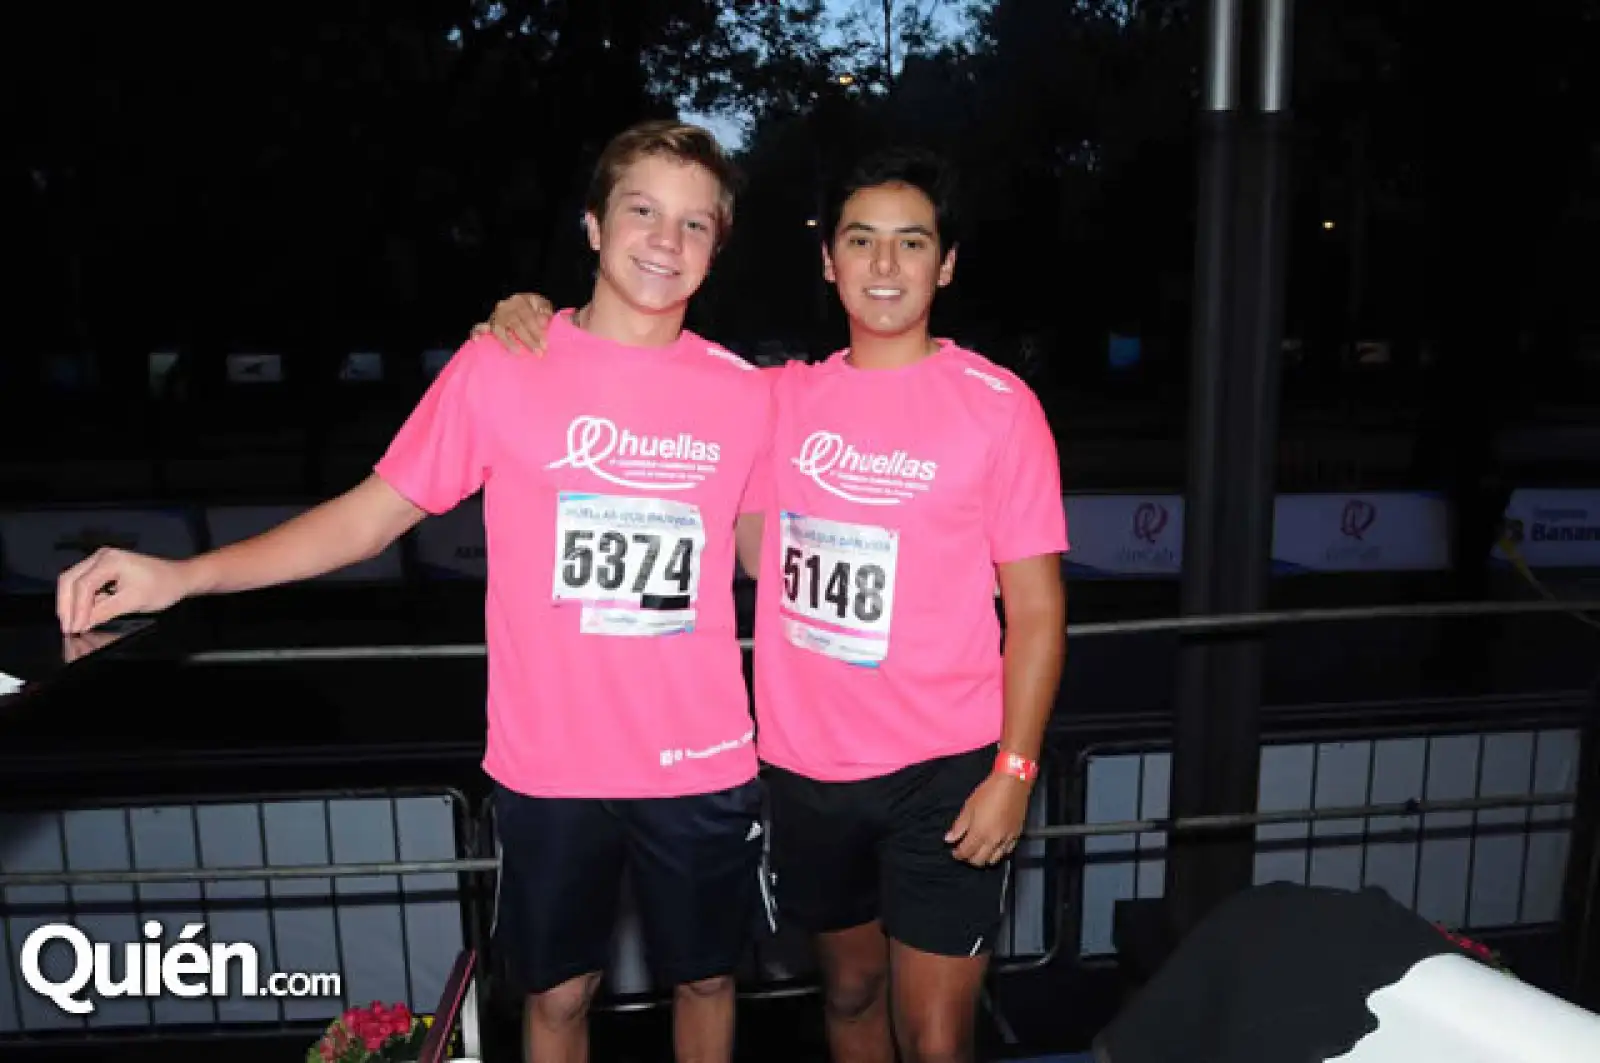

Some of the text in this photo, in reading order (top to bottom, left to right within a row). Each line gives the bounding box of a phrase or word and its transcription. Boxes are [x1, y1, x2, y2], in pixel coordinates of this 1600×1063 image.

[619, 428, 721, 461] huellas
[839, 444, 937, 481] huellas
[562, 529, 694, 593] 5374
[784, 547, 886, 623] 5148
